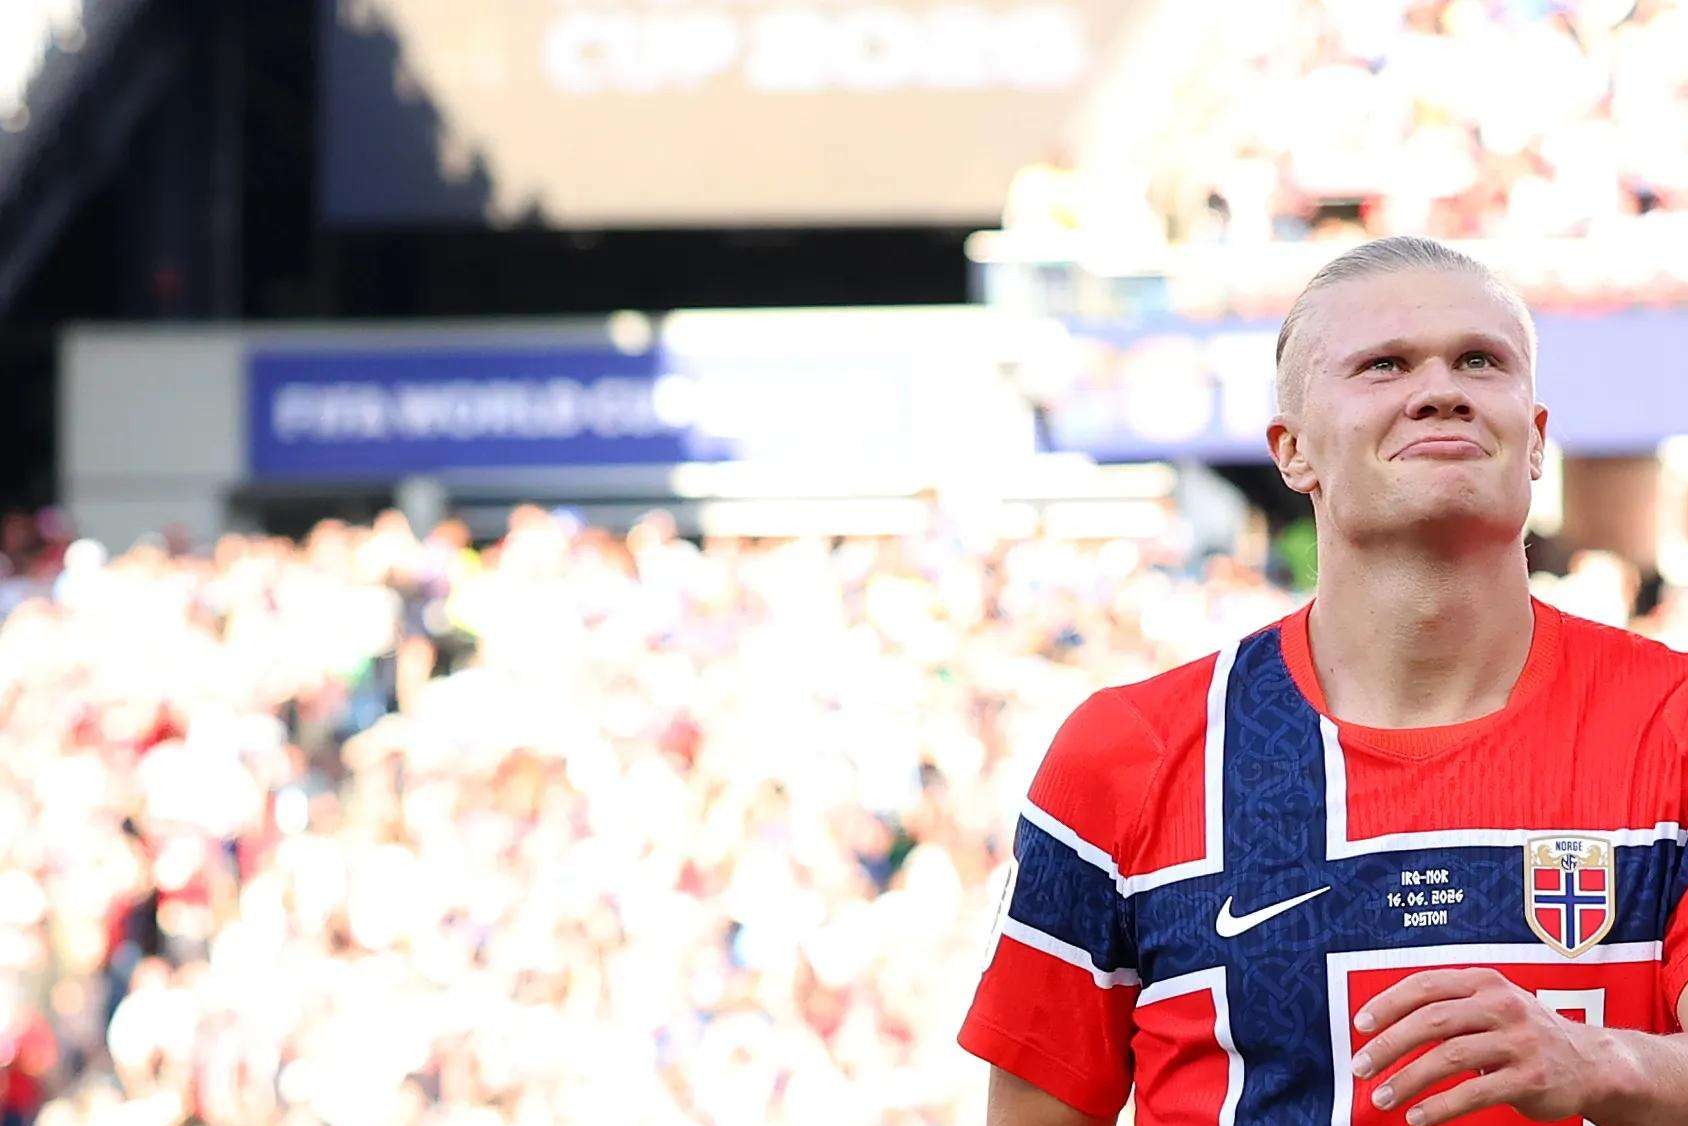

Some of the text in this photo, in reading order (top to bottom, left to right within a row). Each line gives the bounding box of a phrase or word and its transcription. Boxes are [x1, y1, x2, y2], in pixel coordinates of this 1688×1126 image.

[1555, 840, 1583, 852] NORGE
[1401, 869, 1449, 886] IRQ-NOR
[1403, 910, 1448, 928] BOSTON
